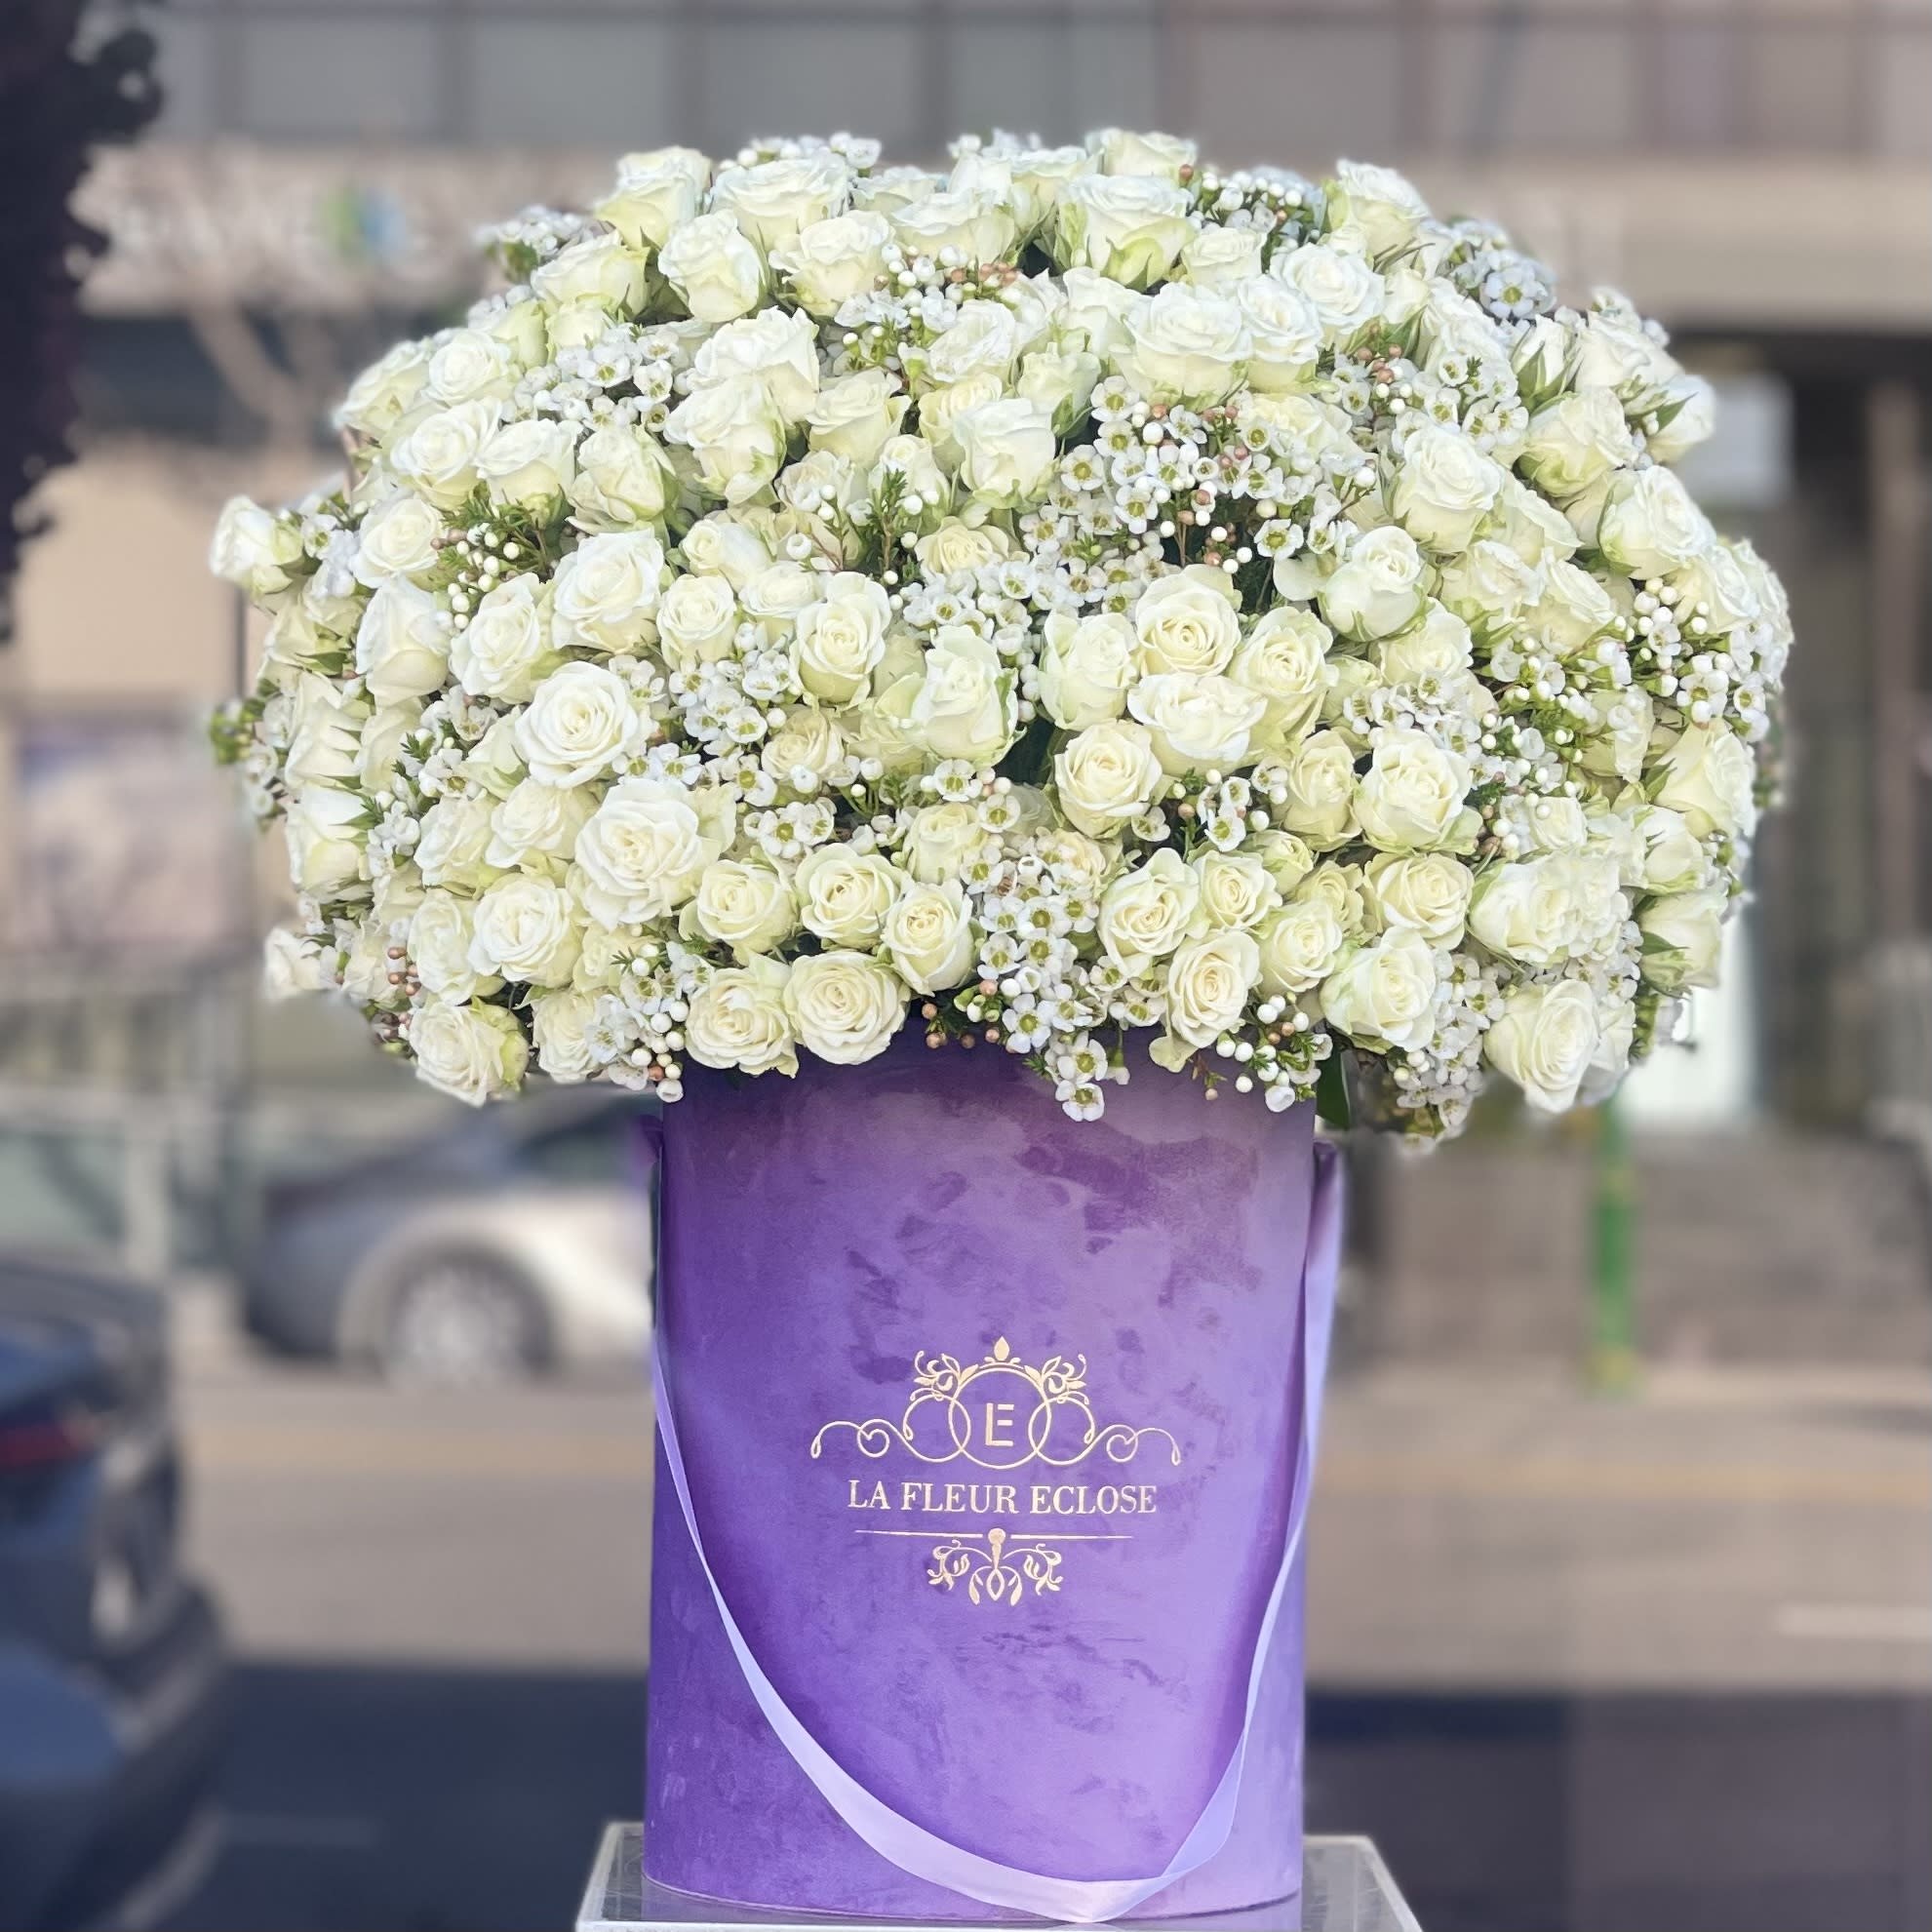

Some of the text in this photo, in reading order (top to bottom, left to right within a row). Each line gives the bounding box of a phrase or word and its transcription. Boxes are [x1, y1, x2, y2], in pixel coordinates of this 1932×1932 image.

[848, 1479, 1157, 1515] LA FLEUR ECLOSE
